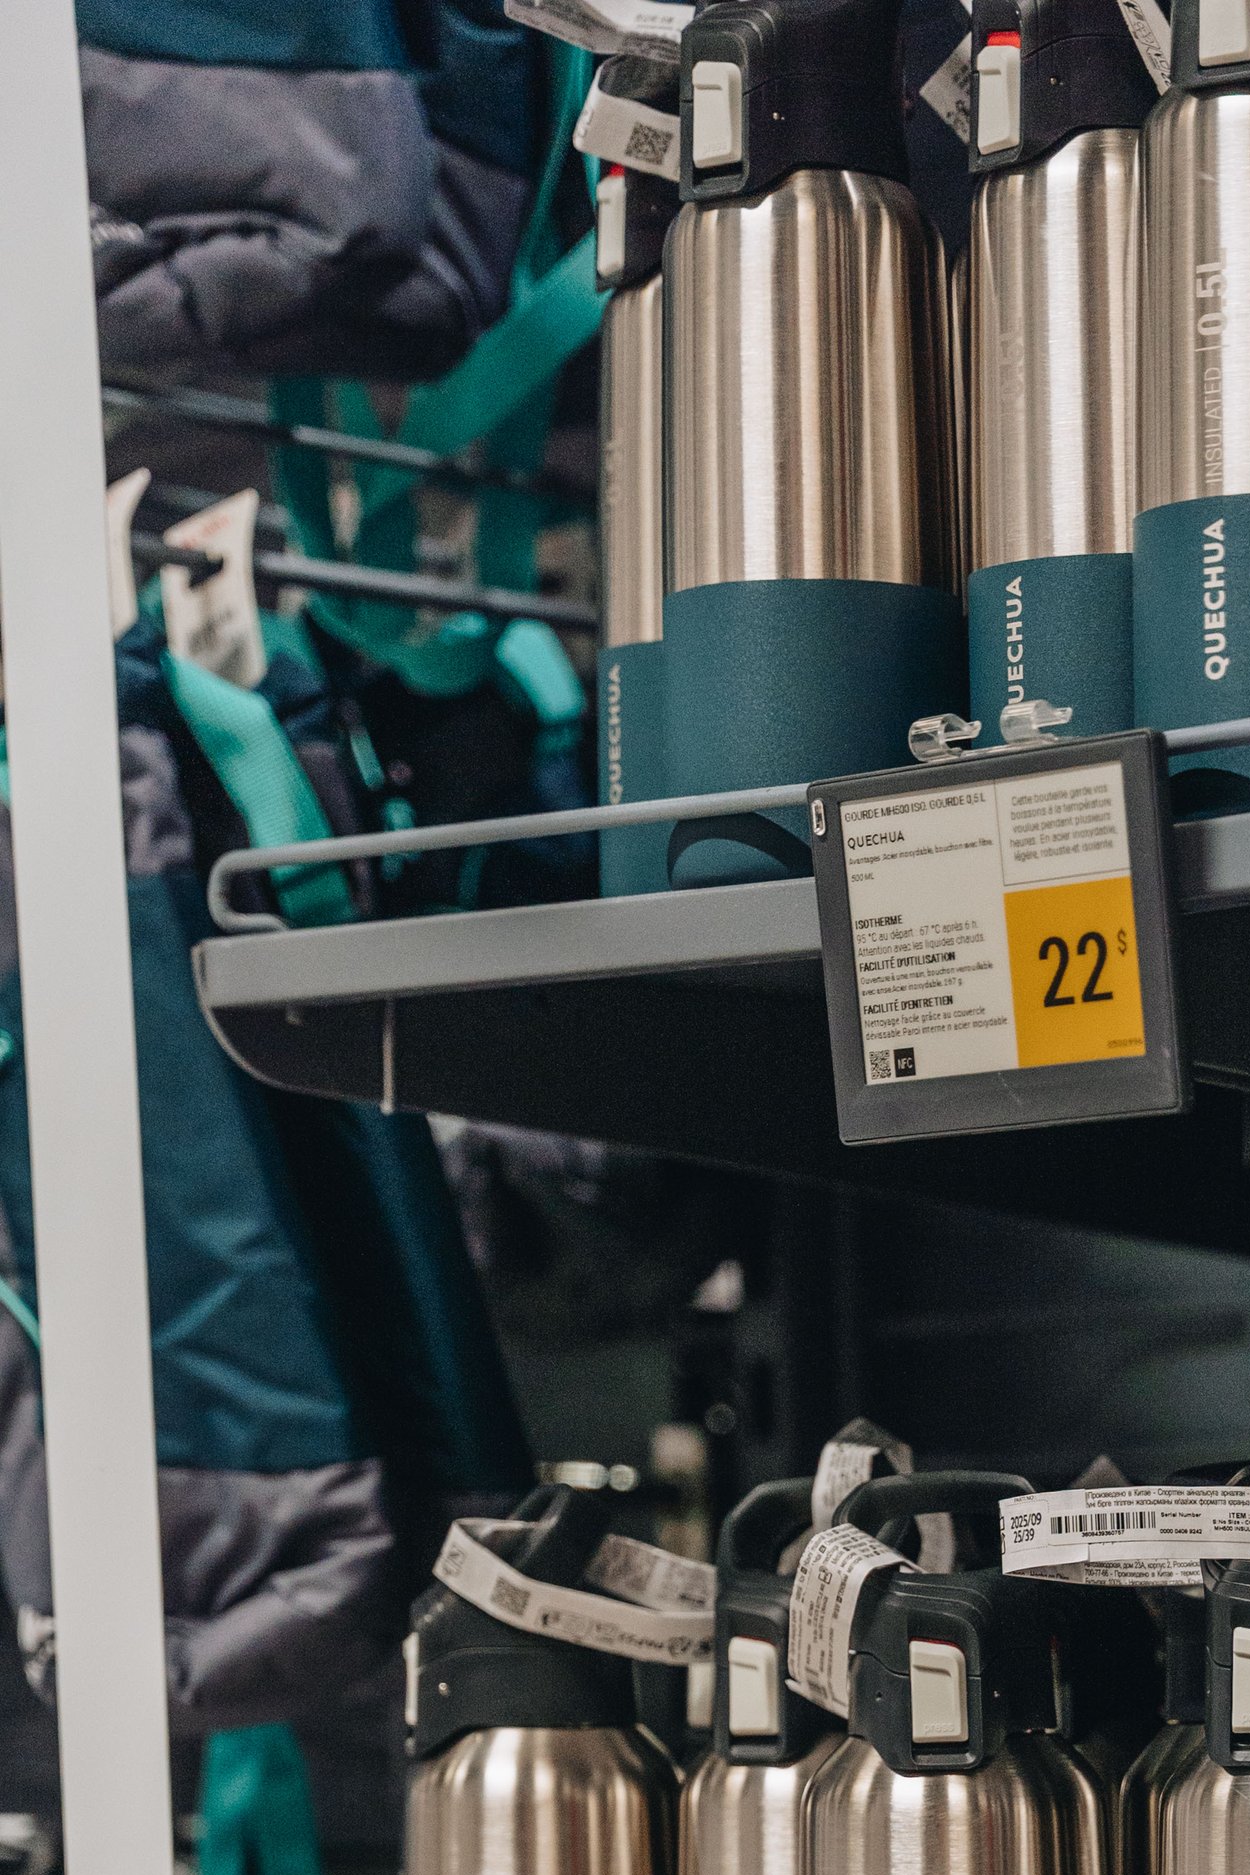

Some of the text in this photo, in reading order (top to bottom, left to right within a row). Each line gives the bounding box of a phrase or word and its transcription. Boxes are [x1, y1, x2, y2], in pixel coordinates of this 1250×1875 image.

[1195, 247, 1228, 486] INSULATED 0.5L
[1203, 518, 1227, 681] QUECHUA
[1006, 575, 1024, 705] UECHUA
[607, 662, 622, 806] QUECHUA
[843, 807, 878, 822] GOURDE
[880, 802, 910, 816] MH500
[929, 795, 964, 810] GOURDE
[847, 830, 904, 850] QUECHUA
[854, 914, 903, 930] ISOTHERME
[877, 929, 888, 941] au
[890, 926, 913, 941] départ
[941, 919, 963, 934] après
[857, 943, 892, 957] Attention
[892, 941, 911, 953] avec
[911, 939, 924, 950] les
[924, 935, 954, 950] liquides
[858, 951, 955, 972] FACILITÉ D'UTILISATION
[1037, 928, 1128, 1007] 22 $
[862, 994, 953, 1015] FACILITÉ D'ENTRETIEN
[863, 1015, 900, 1030] Nettoyage
[900, 1012, 919, 1024] facile
[896, 1057, 913, 1070] NFC
[1010, 1512, 1042, 1529] 2025/09
[1013, 1528, 1035, 1543] 25/39
[923, 1720, 955, 1733] press
